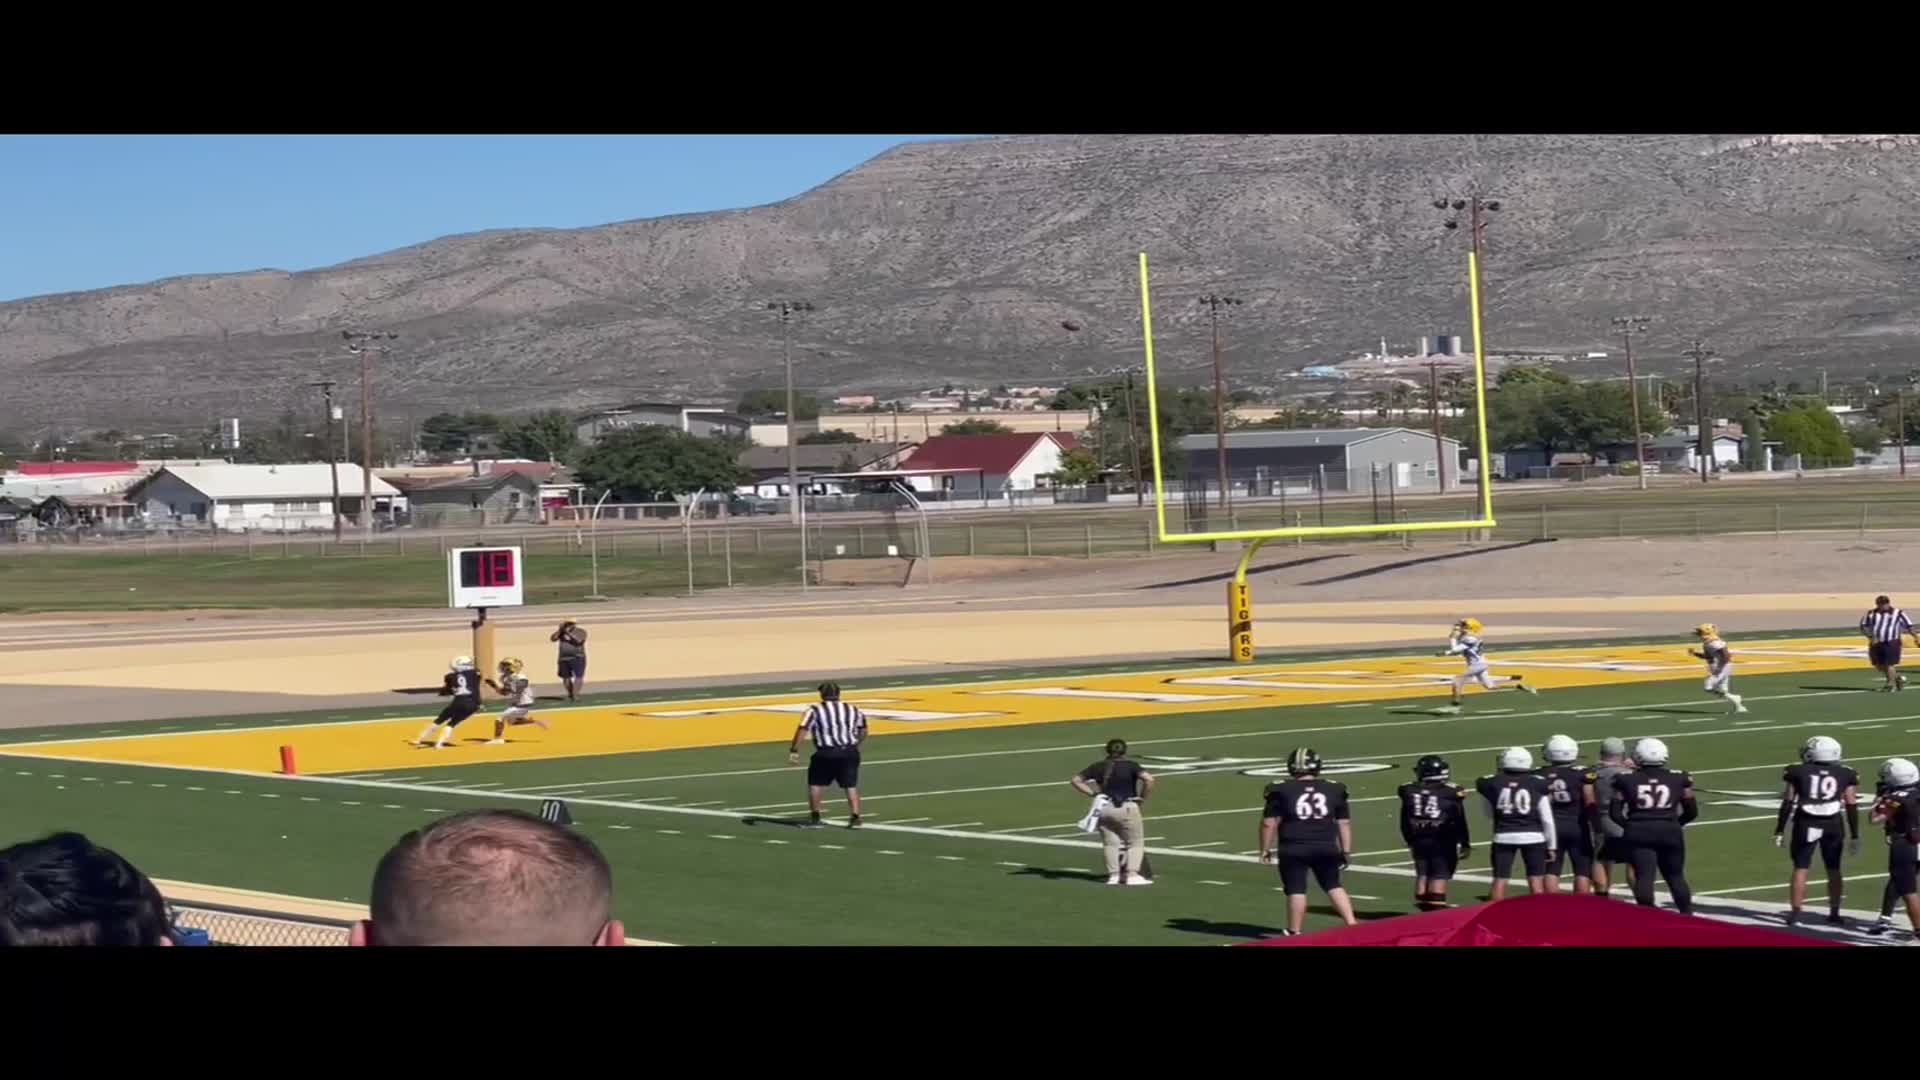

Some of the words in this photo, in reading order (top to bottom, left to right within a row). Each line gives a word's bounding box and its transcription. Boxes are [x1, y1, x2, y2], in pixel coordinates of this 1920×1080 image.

[1238, 585, 1251, 657] TIGRS
[1637, 784, 1672, 809] 52
[1809, 774, 1838, 800] 19
[542, 800, 561, 823] 10
[1296, 792, 1329, 820] 63
[1411, 793, 1441, 819] 14
[1496, 788, 1531, 815] 40
